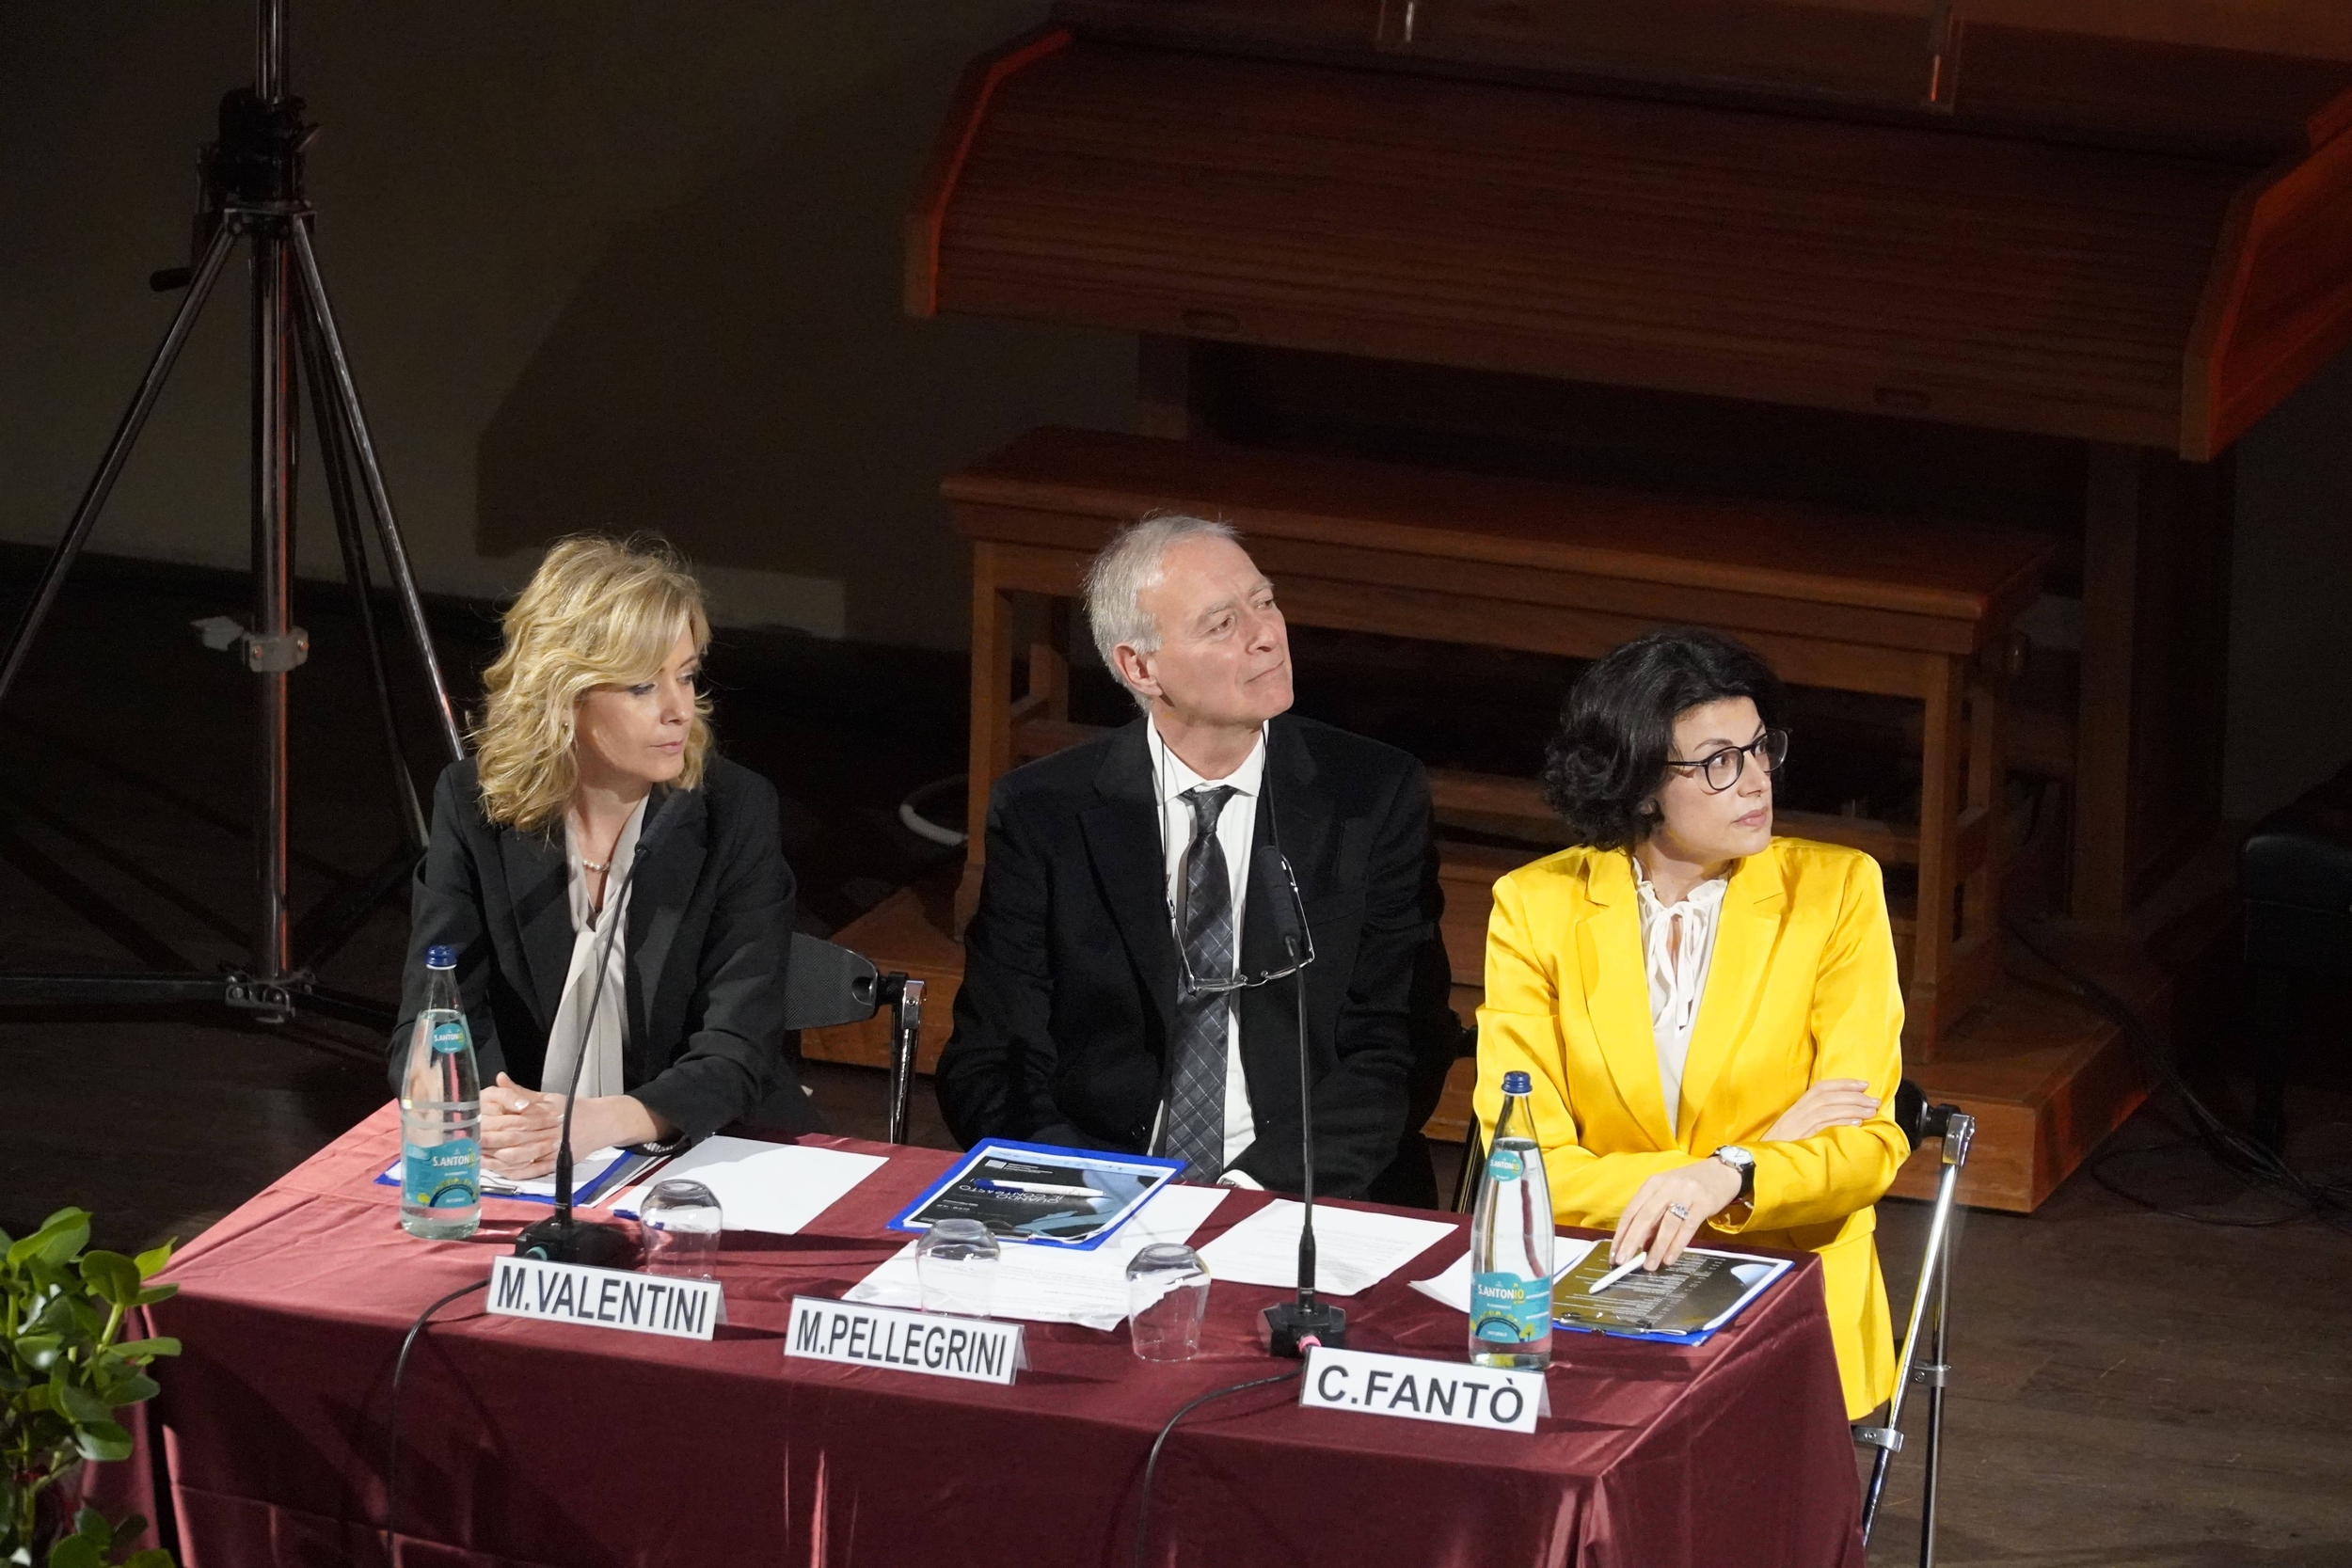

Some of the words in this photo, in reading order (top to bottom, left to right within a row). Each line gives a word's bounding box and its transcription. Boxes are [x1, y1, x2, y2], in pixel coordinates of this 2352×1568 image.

[497, 1265, 708, 1333] M.VALENTINI
[796, 1309, 1007, 1376] M.PELLEGRINI
[1318, 1365, 1523, 1423] C.FANTÒ
